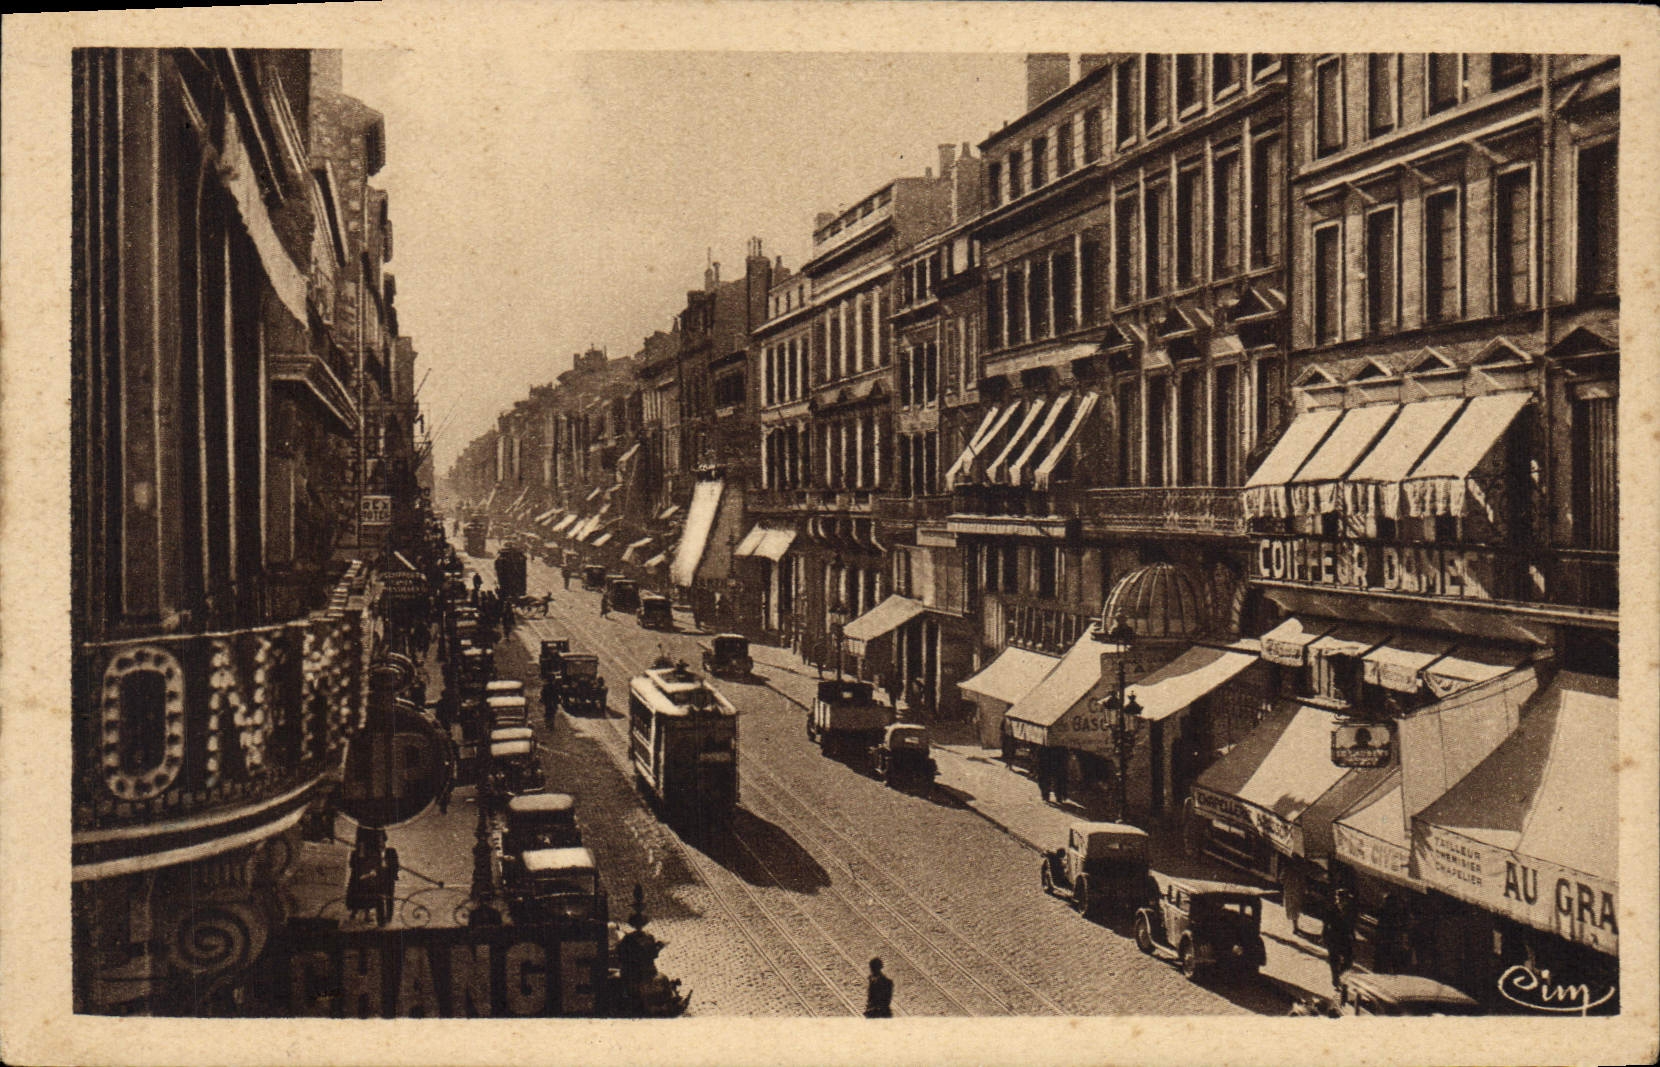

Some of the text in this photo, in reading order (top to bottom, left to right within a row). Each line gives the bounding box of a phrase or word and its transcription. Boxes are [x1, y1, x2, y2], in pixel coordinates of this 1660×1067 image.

[1258, 537, 1369, 591] COIFFEUR
[1434, 836, 1481, 861] TAILLEUR
[1503, 860, 1619, 935] AU GRA
[289, 941, 598, 1017] CHANGE
